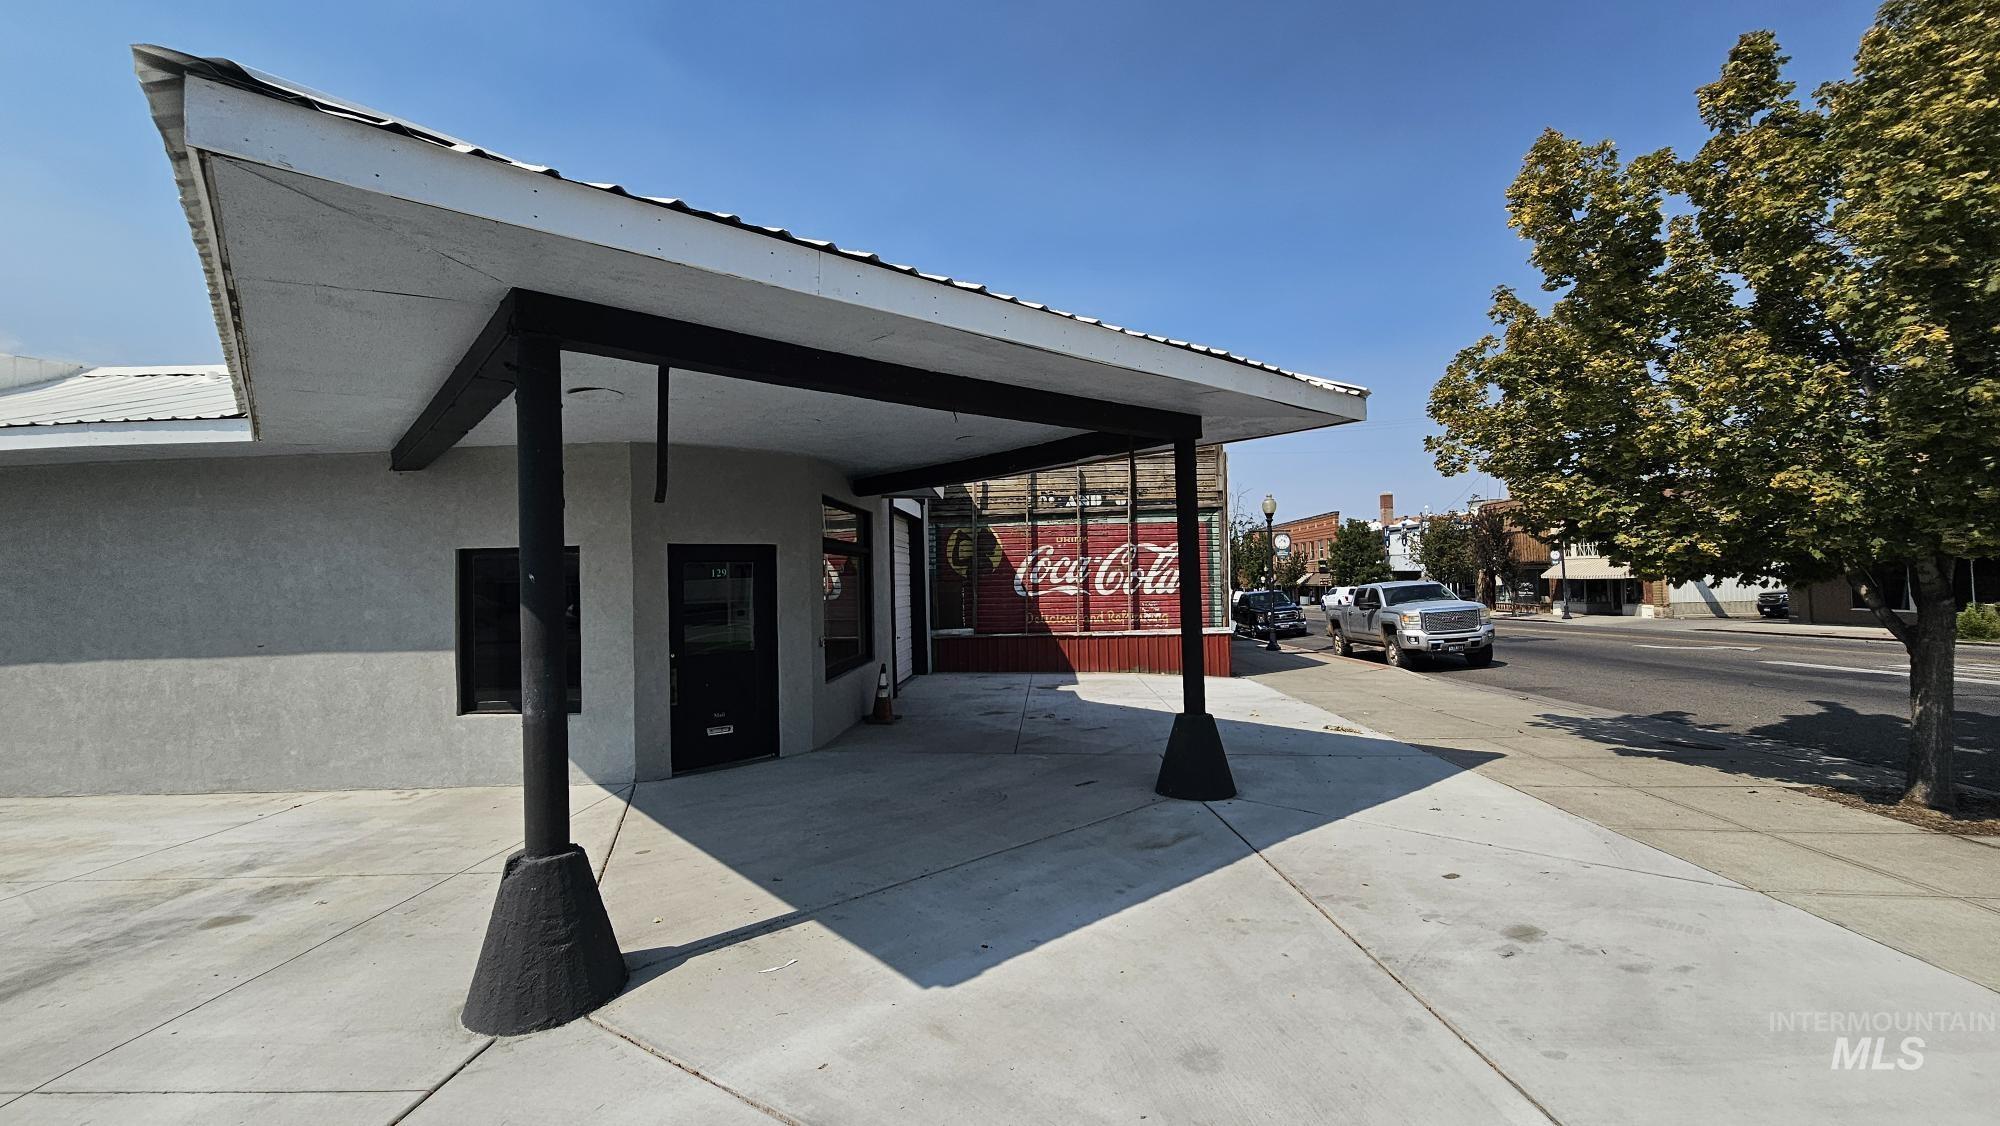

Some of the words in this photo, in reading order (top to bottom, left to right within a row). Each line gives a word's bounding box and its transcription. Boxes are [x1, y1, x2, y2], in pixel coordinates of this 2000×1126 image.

[711, 568, 727, 578] 129
[1013, 542, 1181, 597] Coca-Cola
[1084, 610, 1104, 623] and
